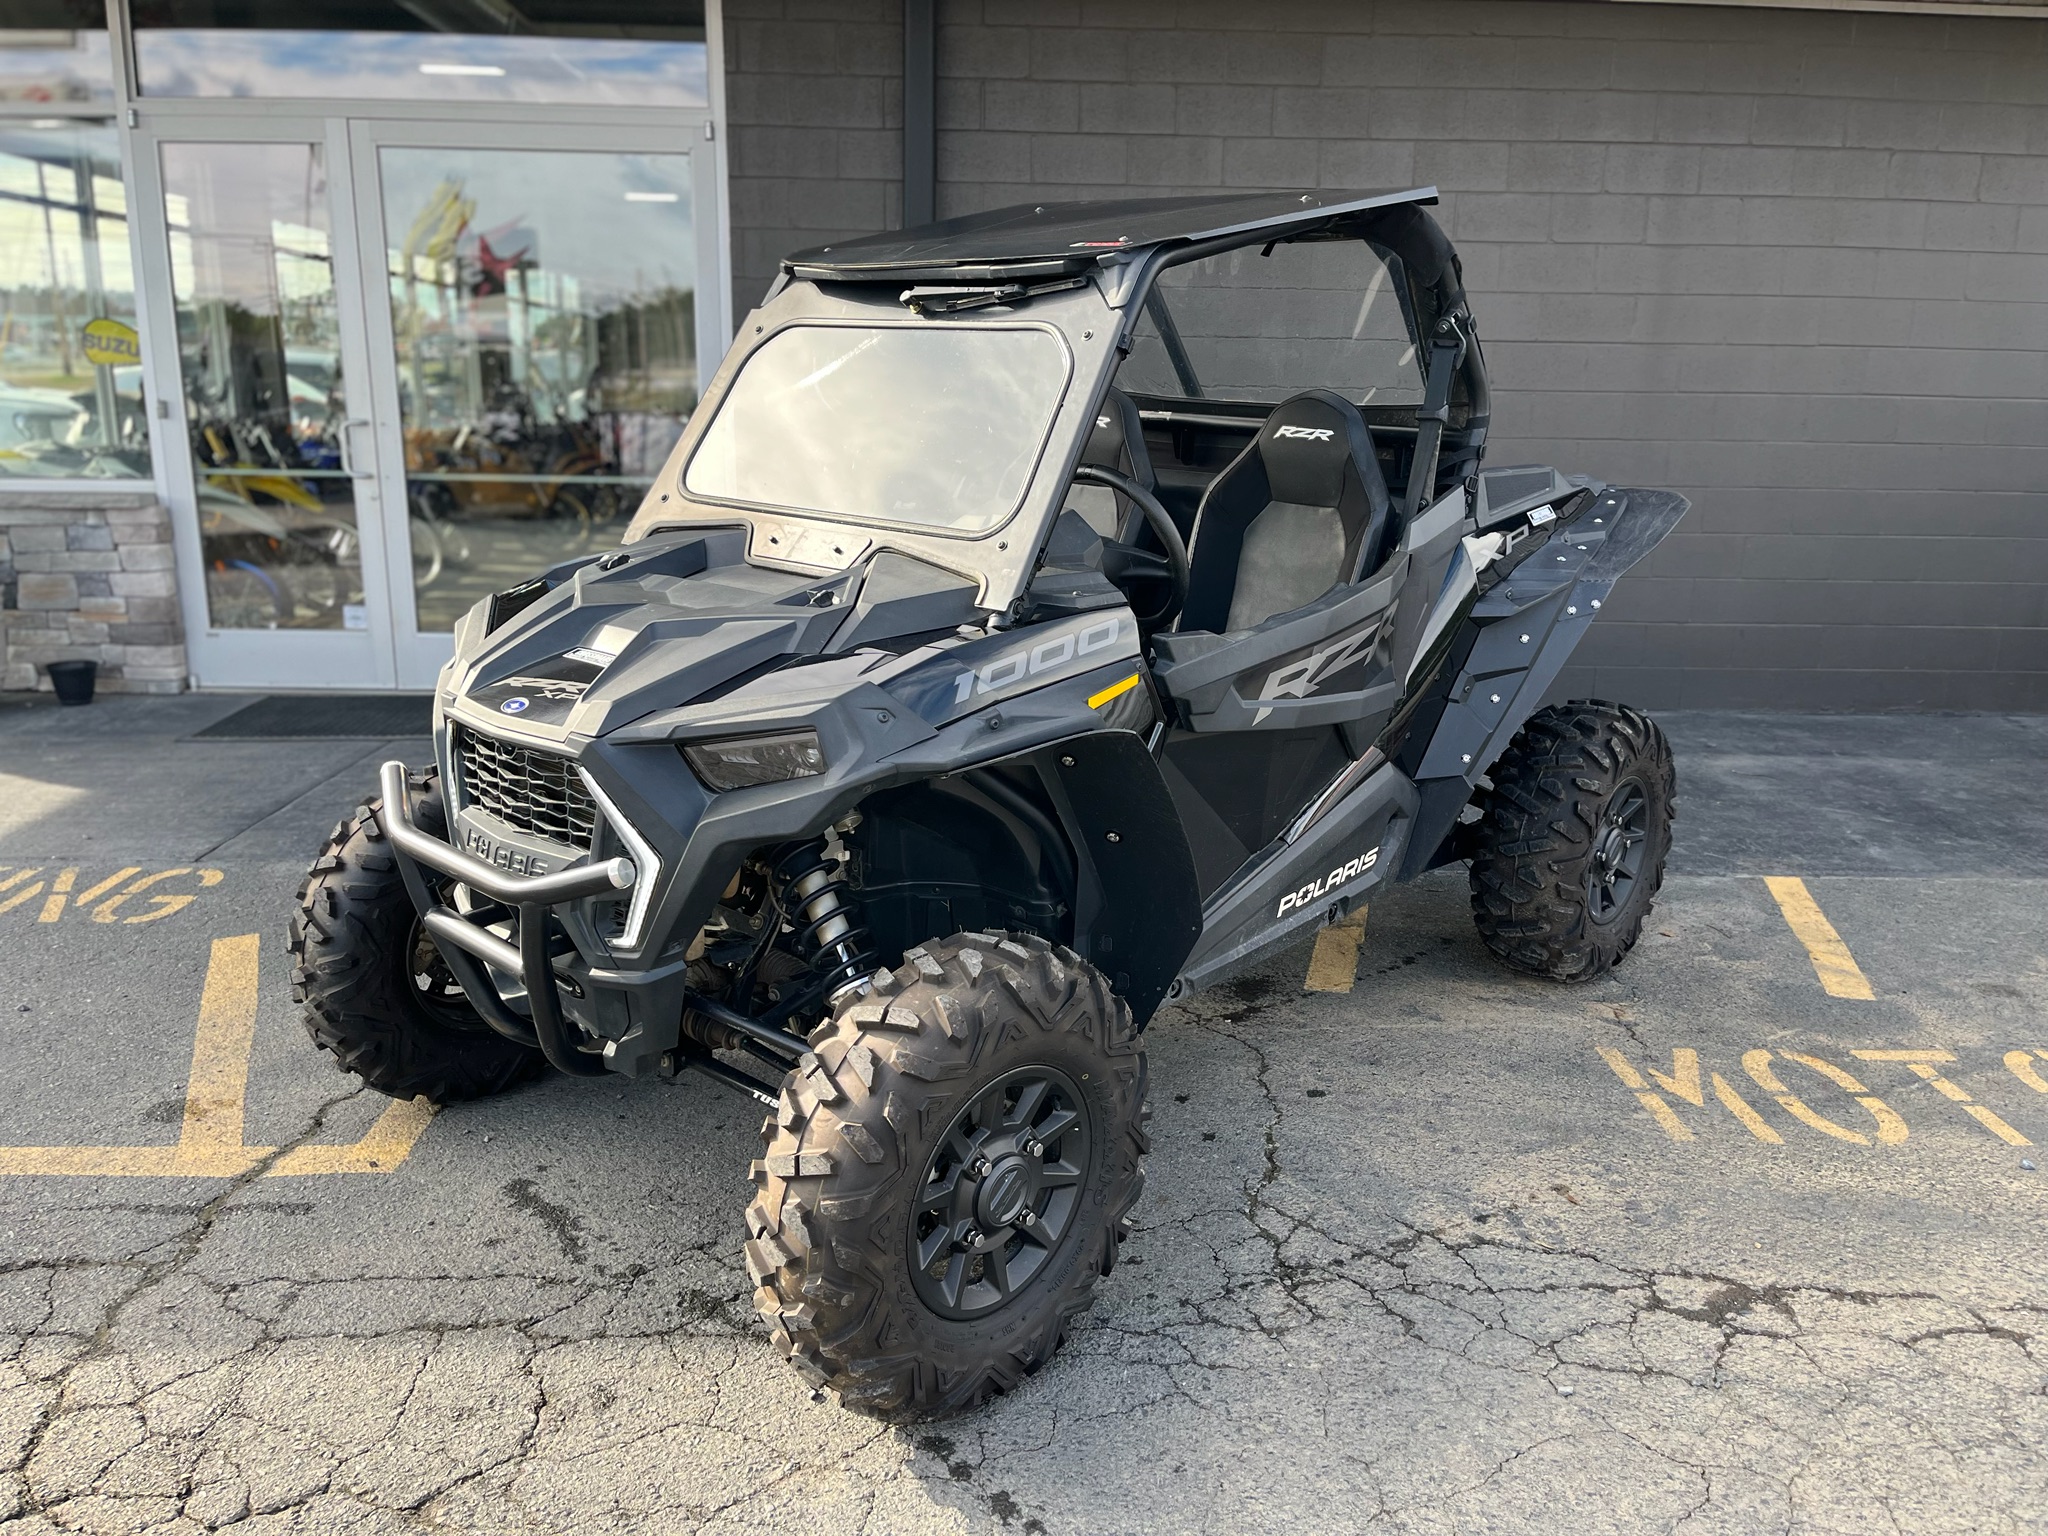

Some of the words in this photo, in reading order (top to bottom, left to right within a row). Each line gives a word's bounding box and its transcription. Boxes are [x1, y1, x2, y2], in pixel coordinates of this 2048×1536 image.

[1273, 425, 1335, 441] RZR
[490, 676, 591, 693] RZR
[953, 618, 1119, 704] 1000
[1252, 598, 1399, 727] RZR
[534, 690, 581, 700] XP
[466, 828, 549, 878] POLARIS
[1276, 846, 1379, 918] POLARIS
